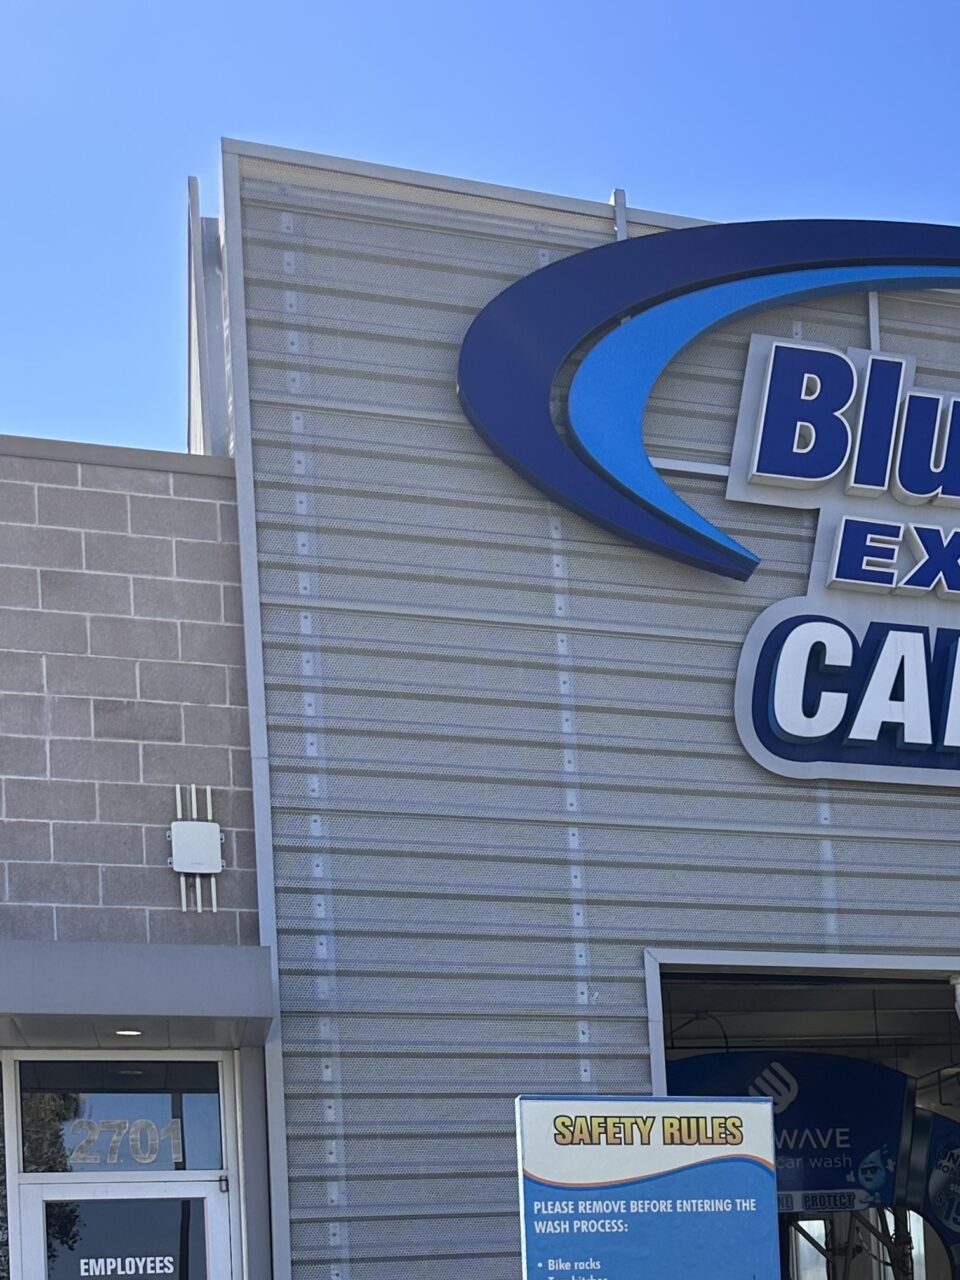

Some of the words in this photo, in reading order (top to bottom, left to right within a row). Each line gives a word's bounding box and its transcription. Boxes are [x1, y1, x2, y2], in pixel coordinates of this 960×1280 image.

[554, 1115, 656, 1146] SAFETY
[662, 1116, 744, 1146] RULES
[69, 1118, 184, 1164] 2701
[776, 1156, 802, 1169] car
[808, 1153, 852, 1169] wash
[534, 1201, 574, 1214] PLEASE
[578, 1200, 626, 1214] REMOVE
[630, 1200, 673, 1213] BEFORE
[676, 1199, 732, 1212] ENTERING
[735, 1199, 756, 1211] THE
[802, 1192, 855, 1210] PROTECT
[534, 1220, 569, 1233] WASH
[573, 1220, 628, 1233] PROCESS:
[80, 1257, 174, 1276] EMPLOYEES
[548, 1260, 571, 1271] Bike
[574, 1259, 601, 1270] racks
